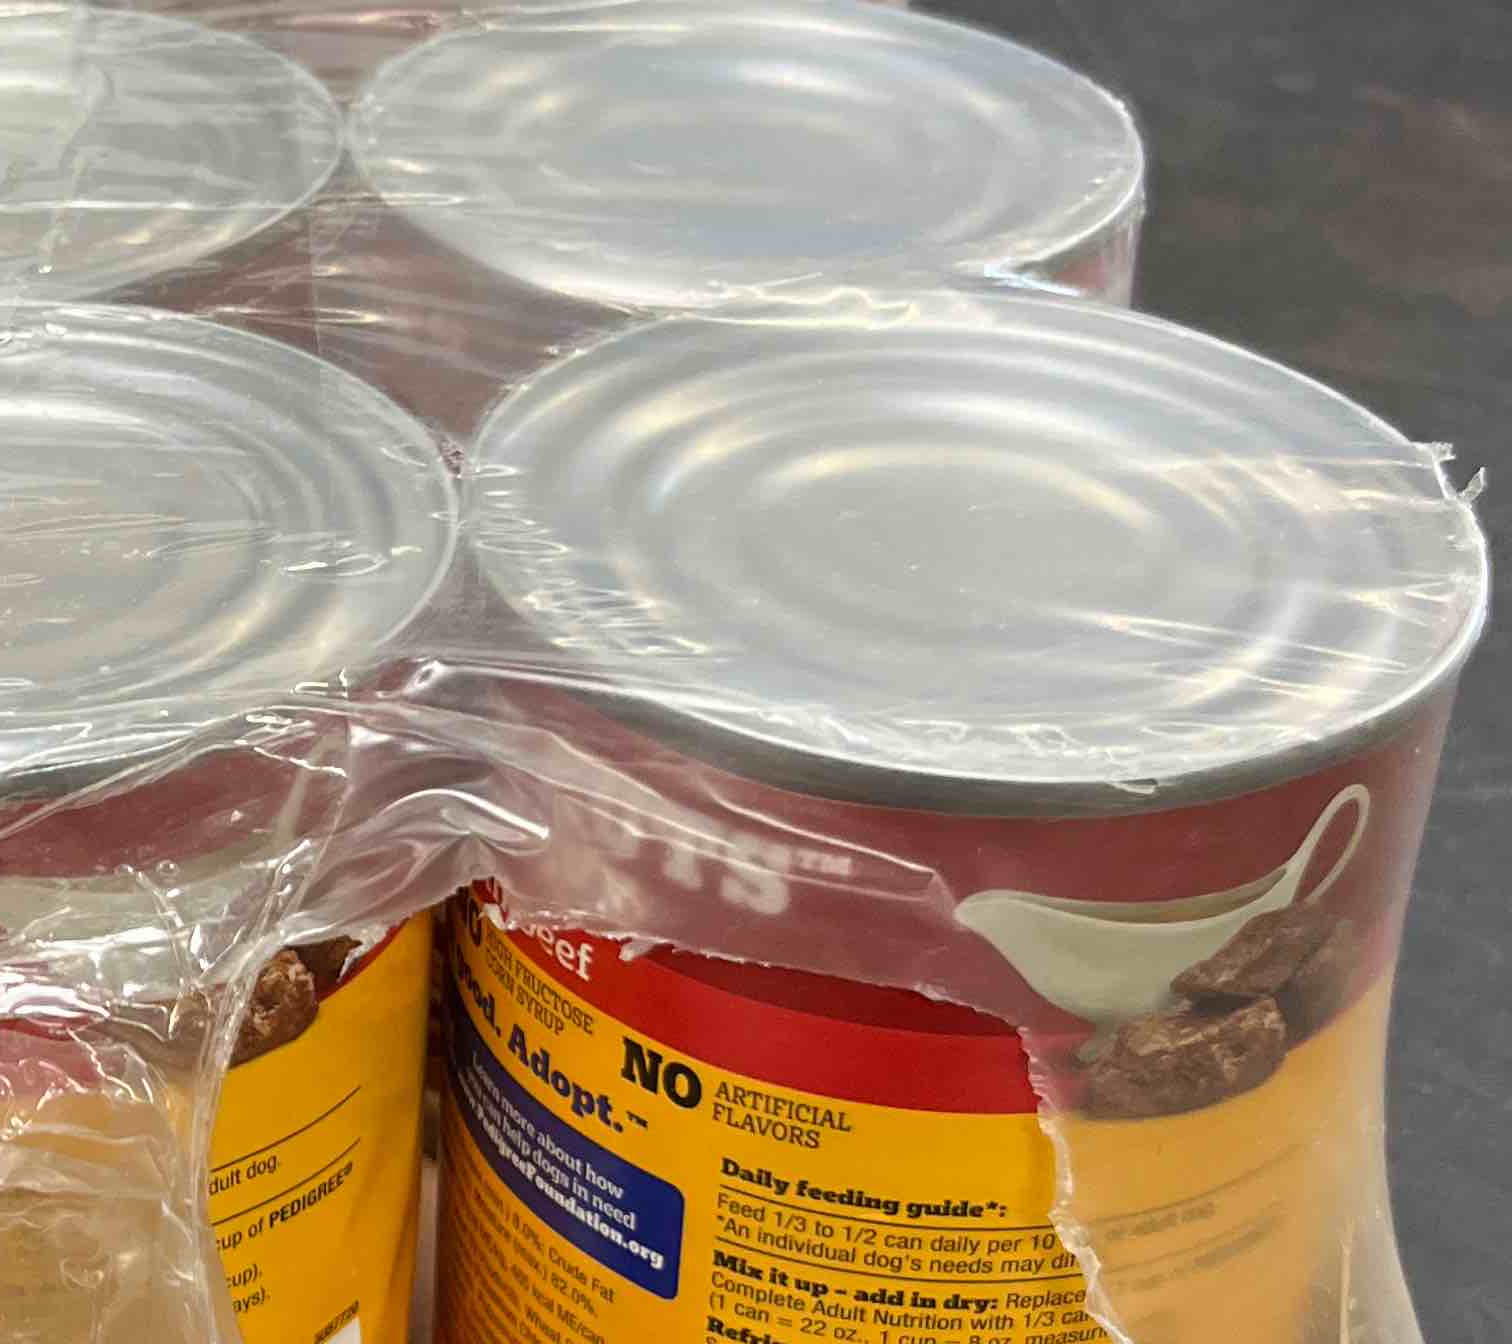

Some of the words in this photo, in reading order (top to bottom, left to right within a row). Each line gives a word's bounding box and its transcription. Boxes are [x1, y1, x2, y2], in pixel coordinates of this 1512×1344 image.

[519, 920, 594, 983] eef
[514, 955, 593, 1038] FRUCTOSE
[518, 982, 563, 1042] SYRUP
[621, 1035, 703, 1110] NO
[714, 1080, 853, 1134] ARTIFICIAL
[711, 1102, 822, 1150] FLAVORS
[207, 1169, 242, 1197] dult
[245, 1154, 282, 1182] dog.
[532, 1144, 568, 1193] dogs
[572, 1177, 588, 1203] in
[592, 1190, 635, 1231] need
[537, 1127, 581, 1177] about
[585, 1163, 623, 1202] how
[719, 1157, 791, 1196] Daily
[796, 1180, 901, 1216] feeding
[247, 1217, 266, 1239] of
[716, 1191, 766, 1223] Feed
[774, 1210, 808, 1233] 1/3
[814, 1220, 835, 1238] to
[842, 1225, 878, 1246] 1/2
[884, 1235, 923, 1251] can
[929, 1234, 981, 1256] daily
[986, 1236, 1023, 1255] per
[1031, 1232, 1056, 1251] 10
[757, 1226, 857, 1264] individual
[863, 1250, 922, 1273] dog's
[929, 1255, 994, 1274] needs
[1000, 1257, 1045, 1276] may
[231, 1287, 271, 1314] ays).
[549, 1243, 586, 1290] Crude
[591, 1274, 616, 1310] Fat
[711, 1270, 806, 1311] Complete
[811, 1299, 867, 1323] Adult
[872, 1308, 963, 1331] Nutrition
[969, 1313, 1014, 1331] with
[1024, 1310, 1056, 1329] 1/3
[712, 1248, 764, 1281] Mix
[768, 1267, 789, 1287] it
[794, 1277, 830, 1298] up
[853, 1287, 904, 1307] add
[909, 1291, 937, 1309] in
[942, 1294, 999, 1313] dry:
[1005, 1288, 1088, 1312] Replace
[708, 1291, 726, 1311] (1
[733, 1302, 771, 1324] can
[777, 1317, 793, 1328] =
[799, 1317, 827, 1337] 22
